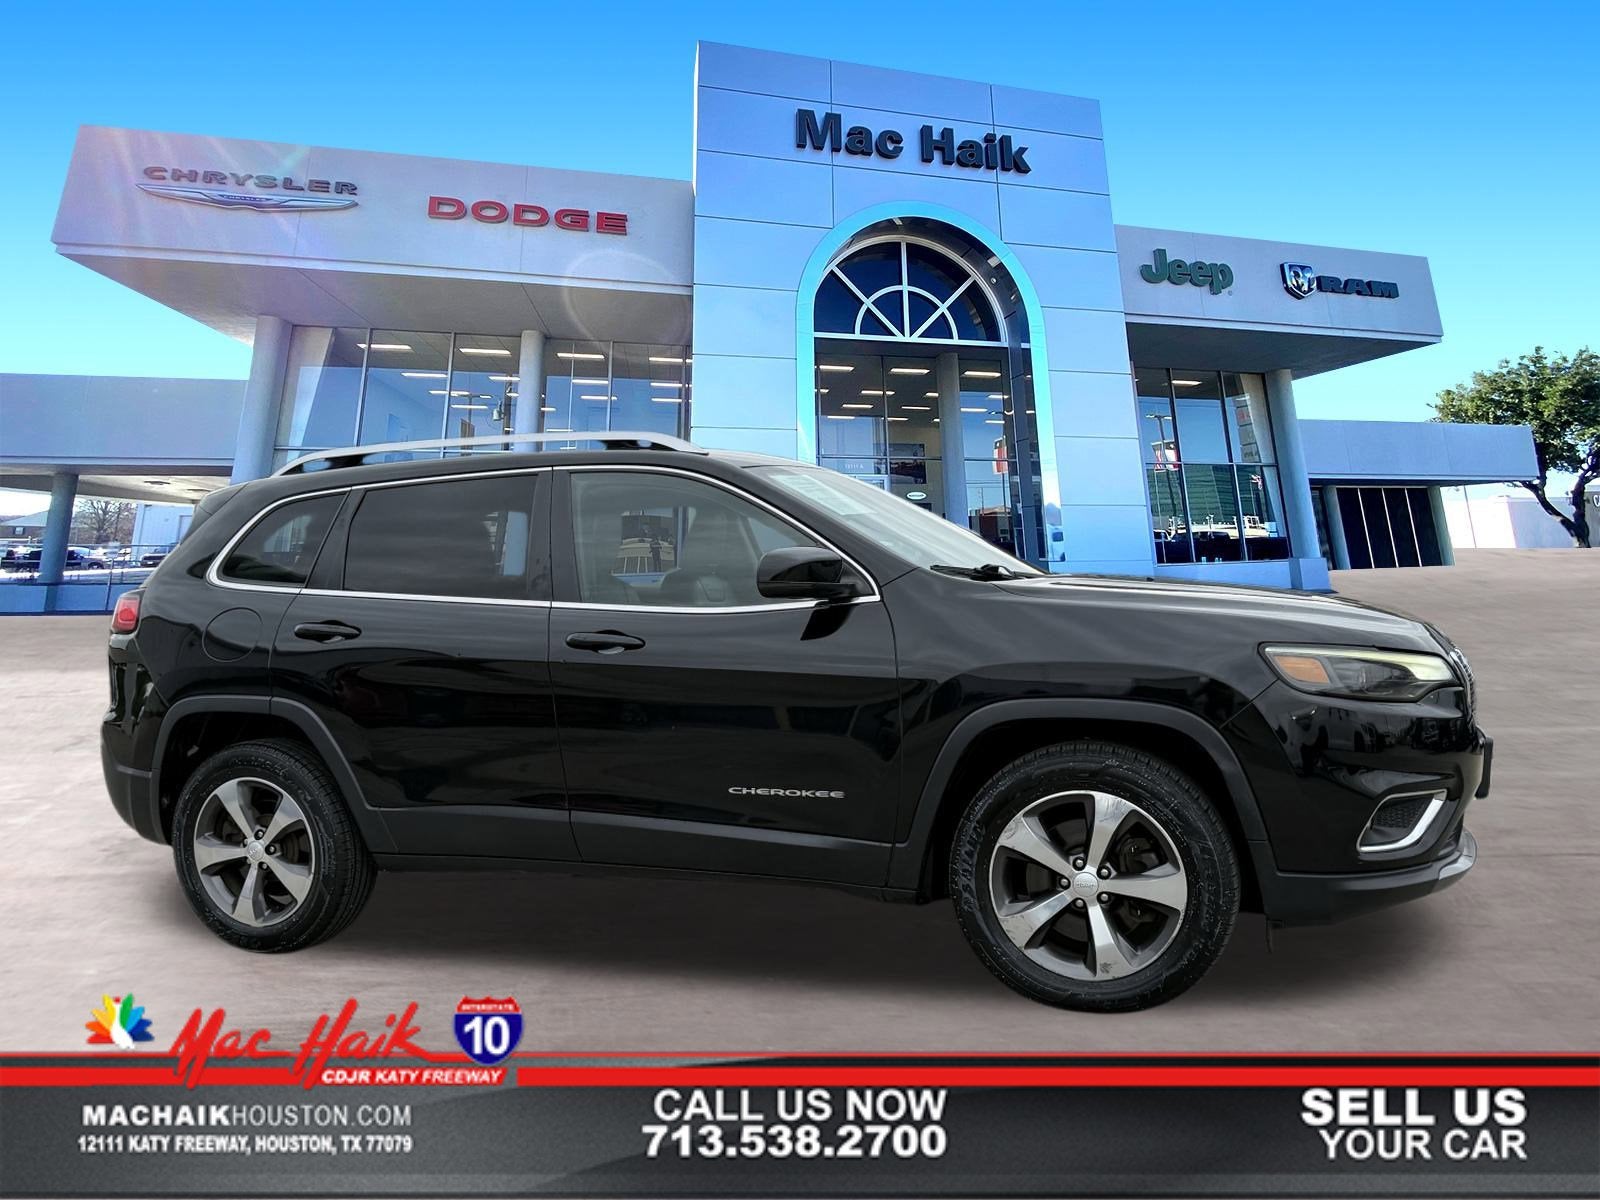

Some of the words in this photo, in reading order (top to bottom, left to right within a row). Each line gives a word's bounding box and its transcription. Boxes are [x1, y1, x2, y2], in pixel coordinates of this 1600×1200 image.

[796, 108, 904, 160] Mac
[919, 124, 1032, 174] Haik
[143, 166, 358, 196] CHRYSLER
[427, 195, 629, 236] DODGE
[1139, 248, 1234, 296] Jeep
[1316, 275, 1399, 299] RAM
[728, 786, 846, 799] CHEROKEE
